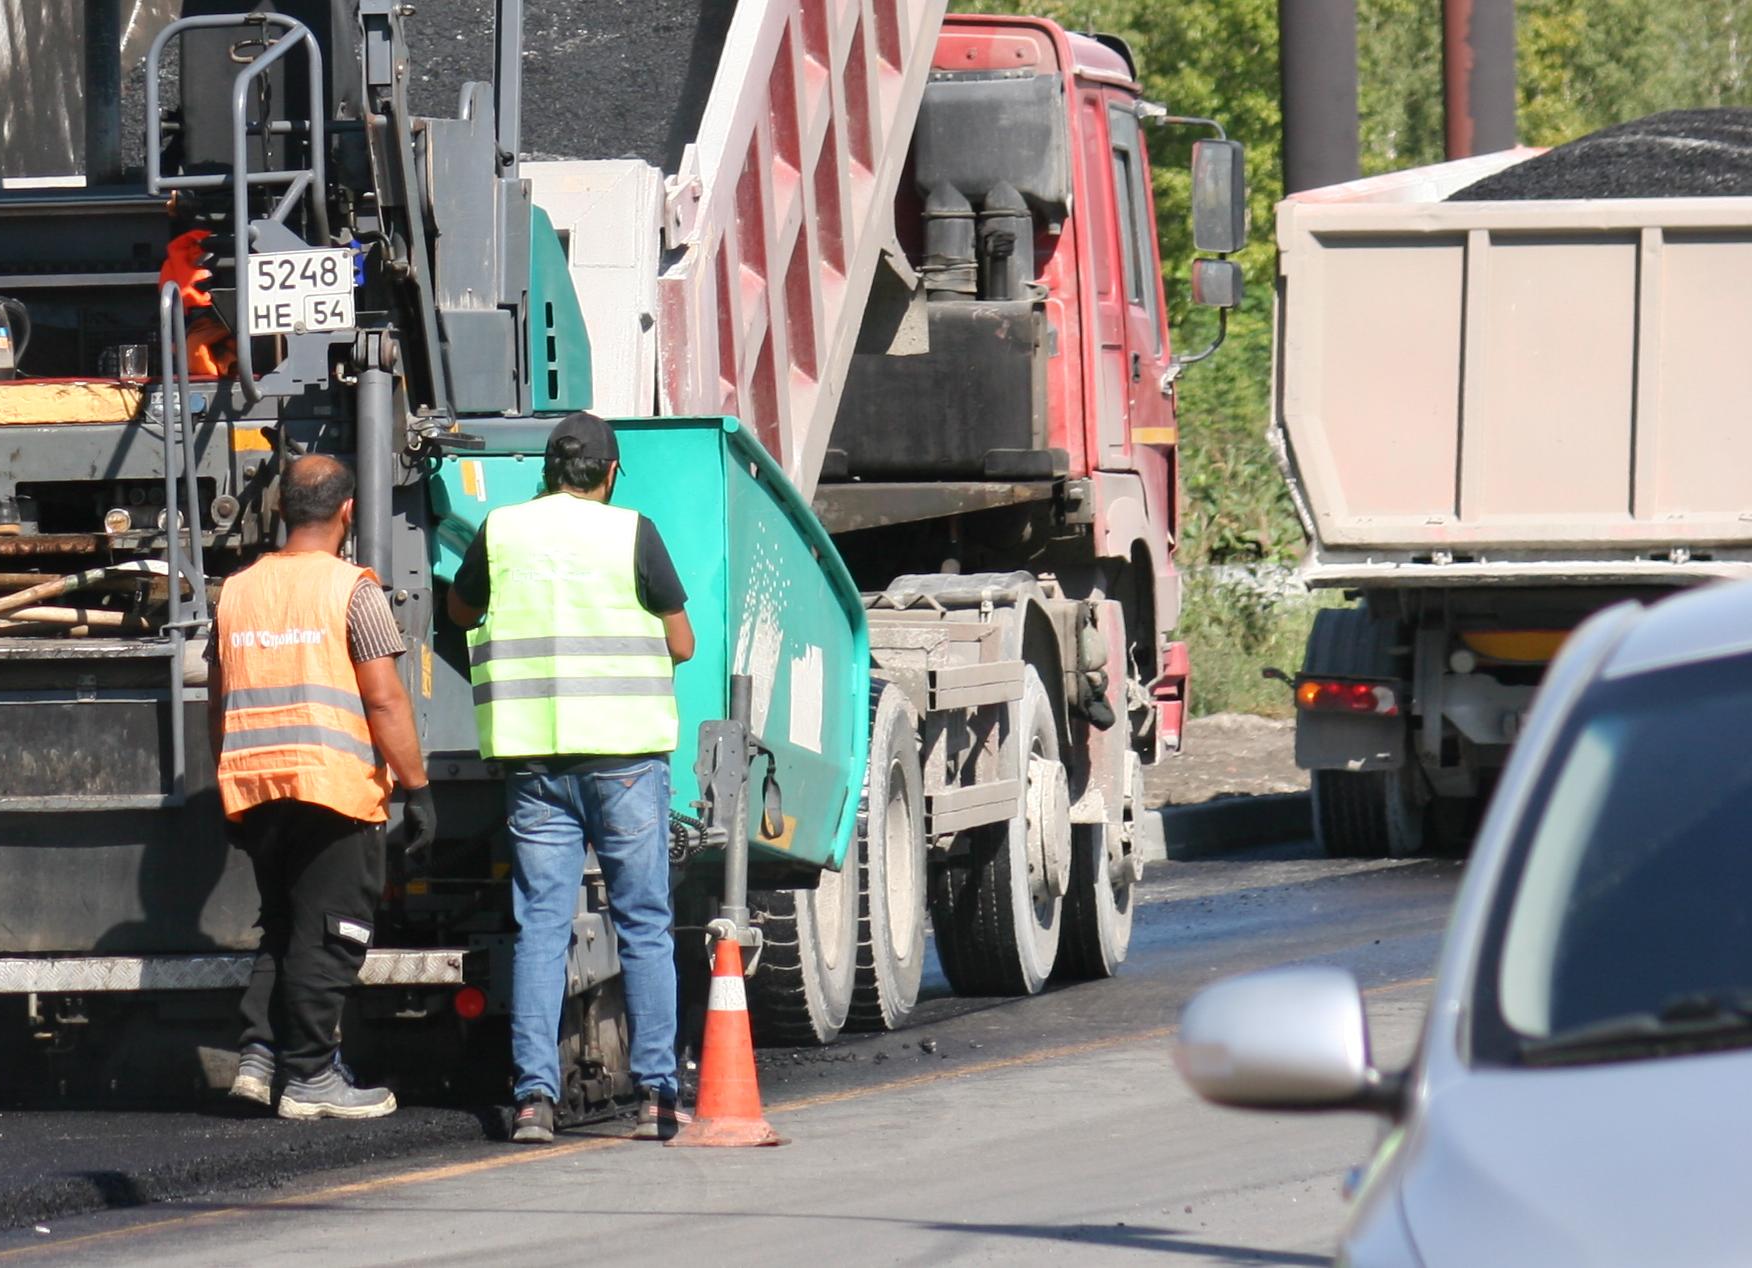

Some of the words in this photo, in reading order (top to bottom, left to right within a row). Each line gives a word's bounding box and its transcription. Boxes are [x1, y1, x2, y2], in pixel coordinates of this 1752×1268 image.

[258, 256, 338, 291] 5248
[254, 303, 292, 329] НЕ
[314, 299, 344, 325] 54
